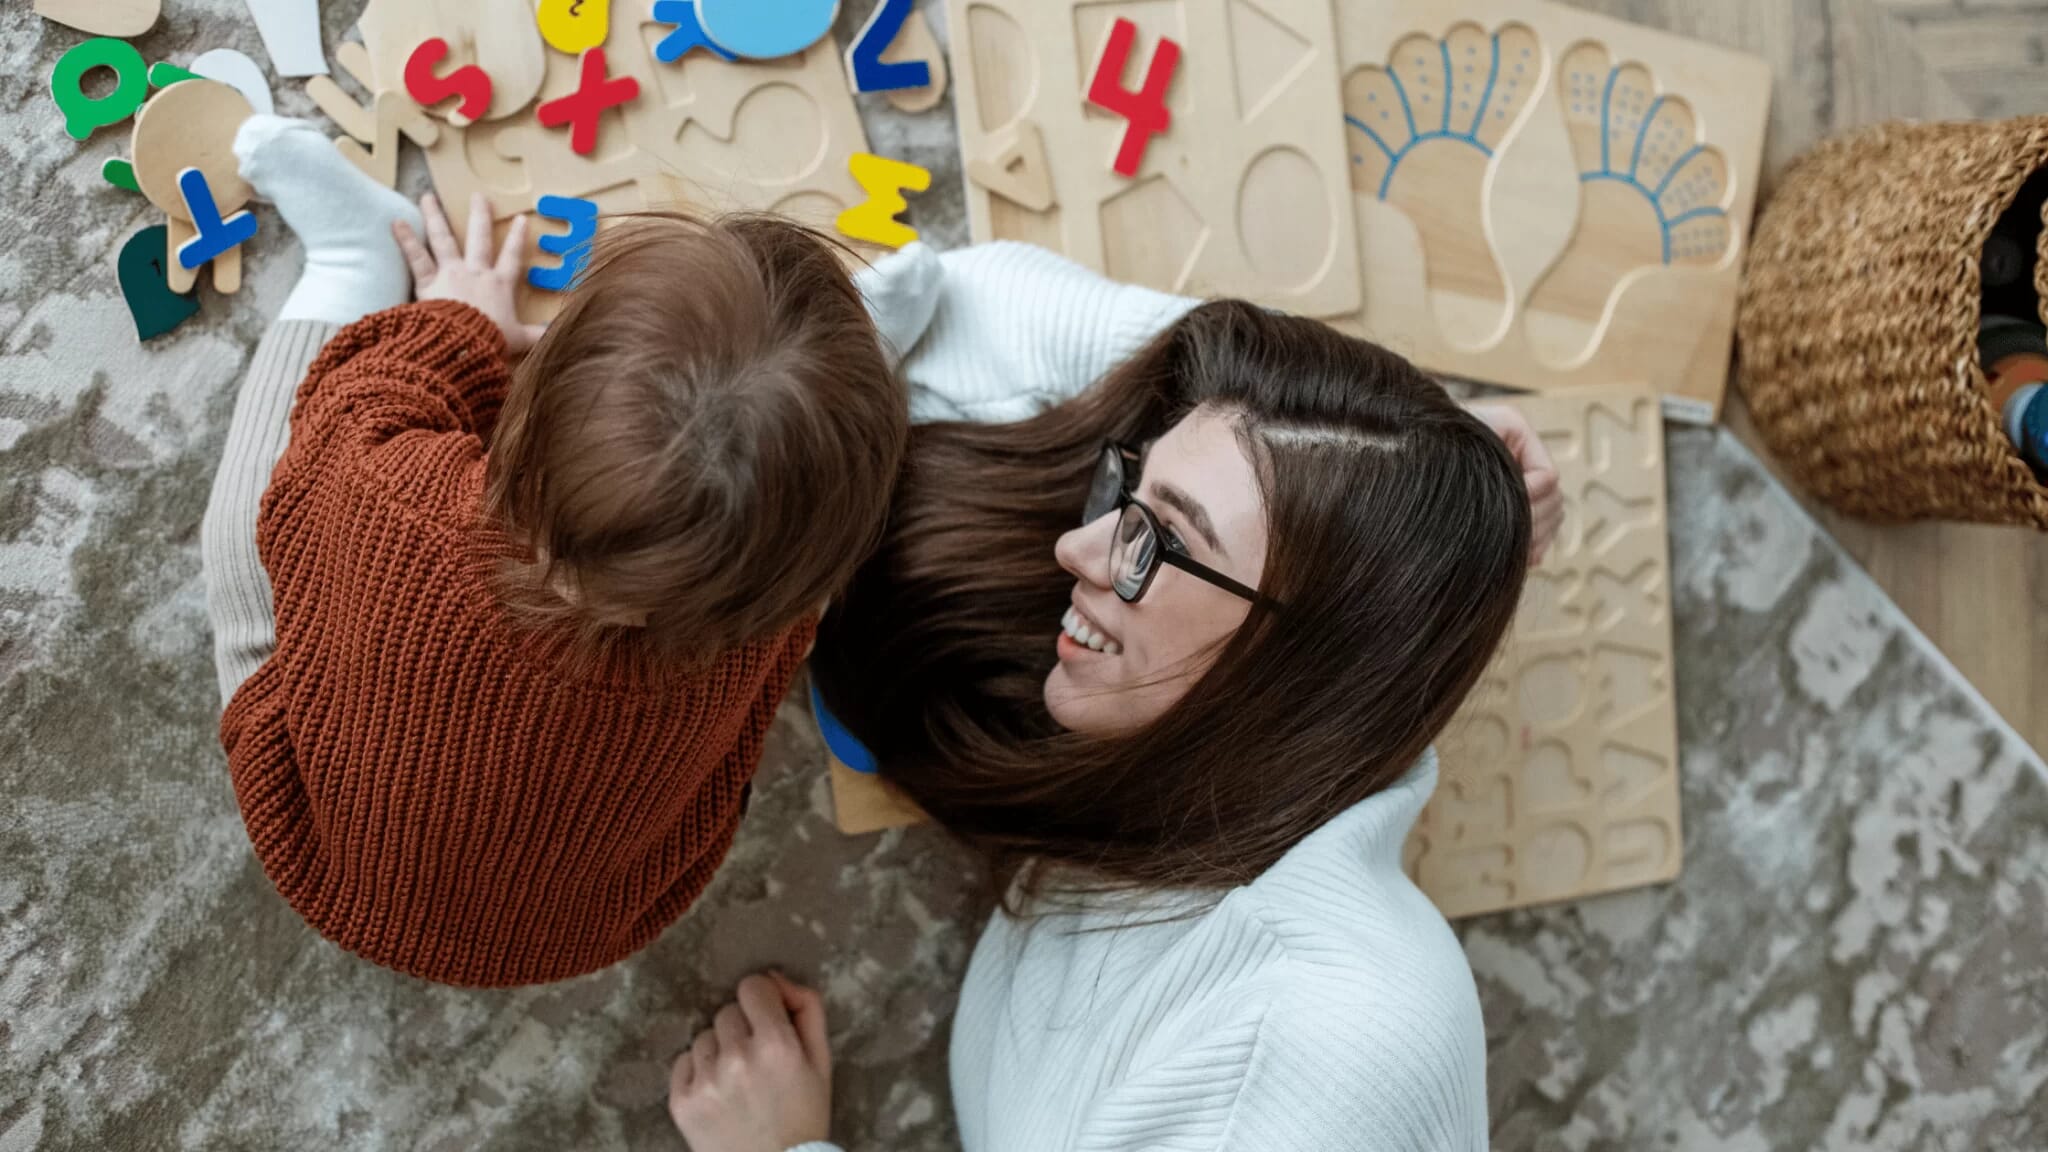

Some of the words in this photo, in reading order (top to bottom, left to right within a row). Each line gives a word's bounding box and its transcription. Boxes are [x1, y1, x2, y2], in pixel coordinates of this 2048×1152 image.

[404, 37, 492, 126] S
[536, 46, 640, 155] X
[1084, 17, 1182, 179] 4
